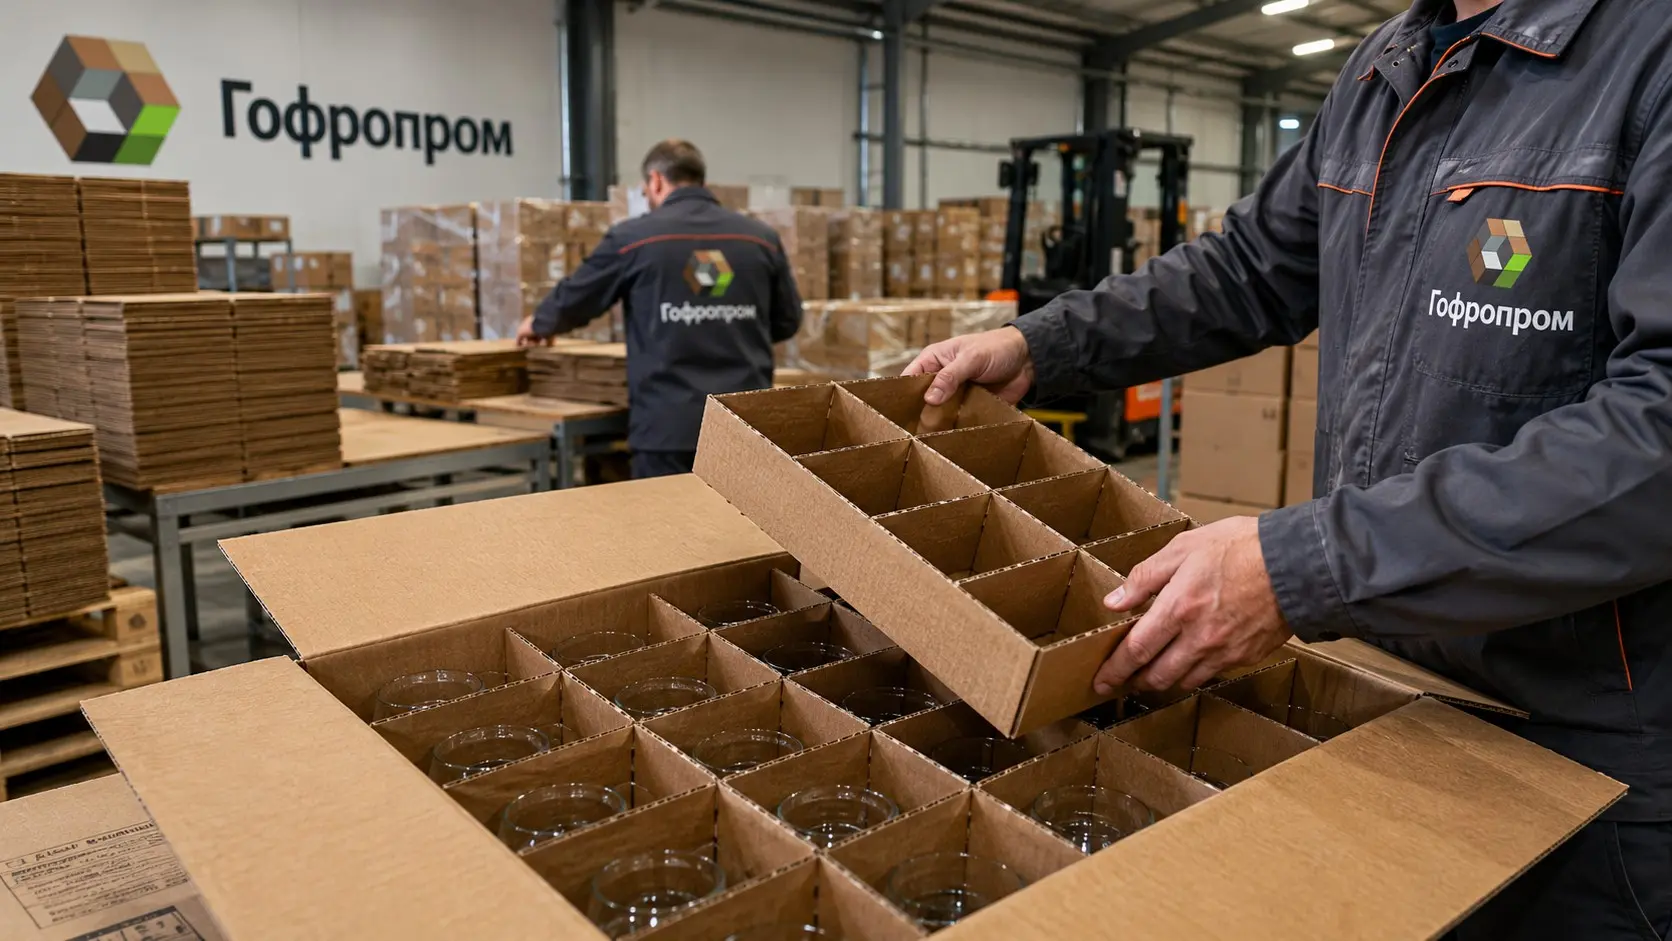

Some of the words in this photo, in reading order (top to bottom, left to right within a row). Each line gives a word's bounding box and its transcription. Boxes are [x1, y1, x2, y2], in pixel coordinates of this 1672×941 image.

[221, 78, 514, 166] Гофропром
[660, 301, 757, 326] Гофропром
[1428, 289, 1574, 336] Гофропром
